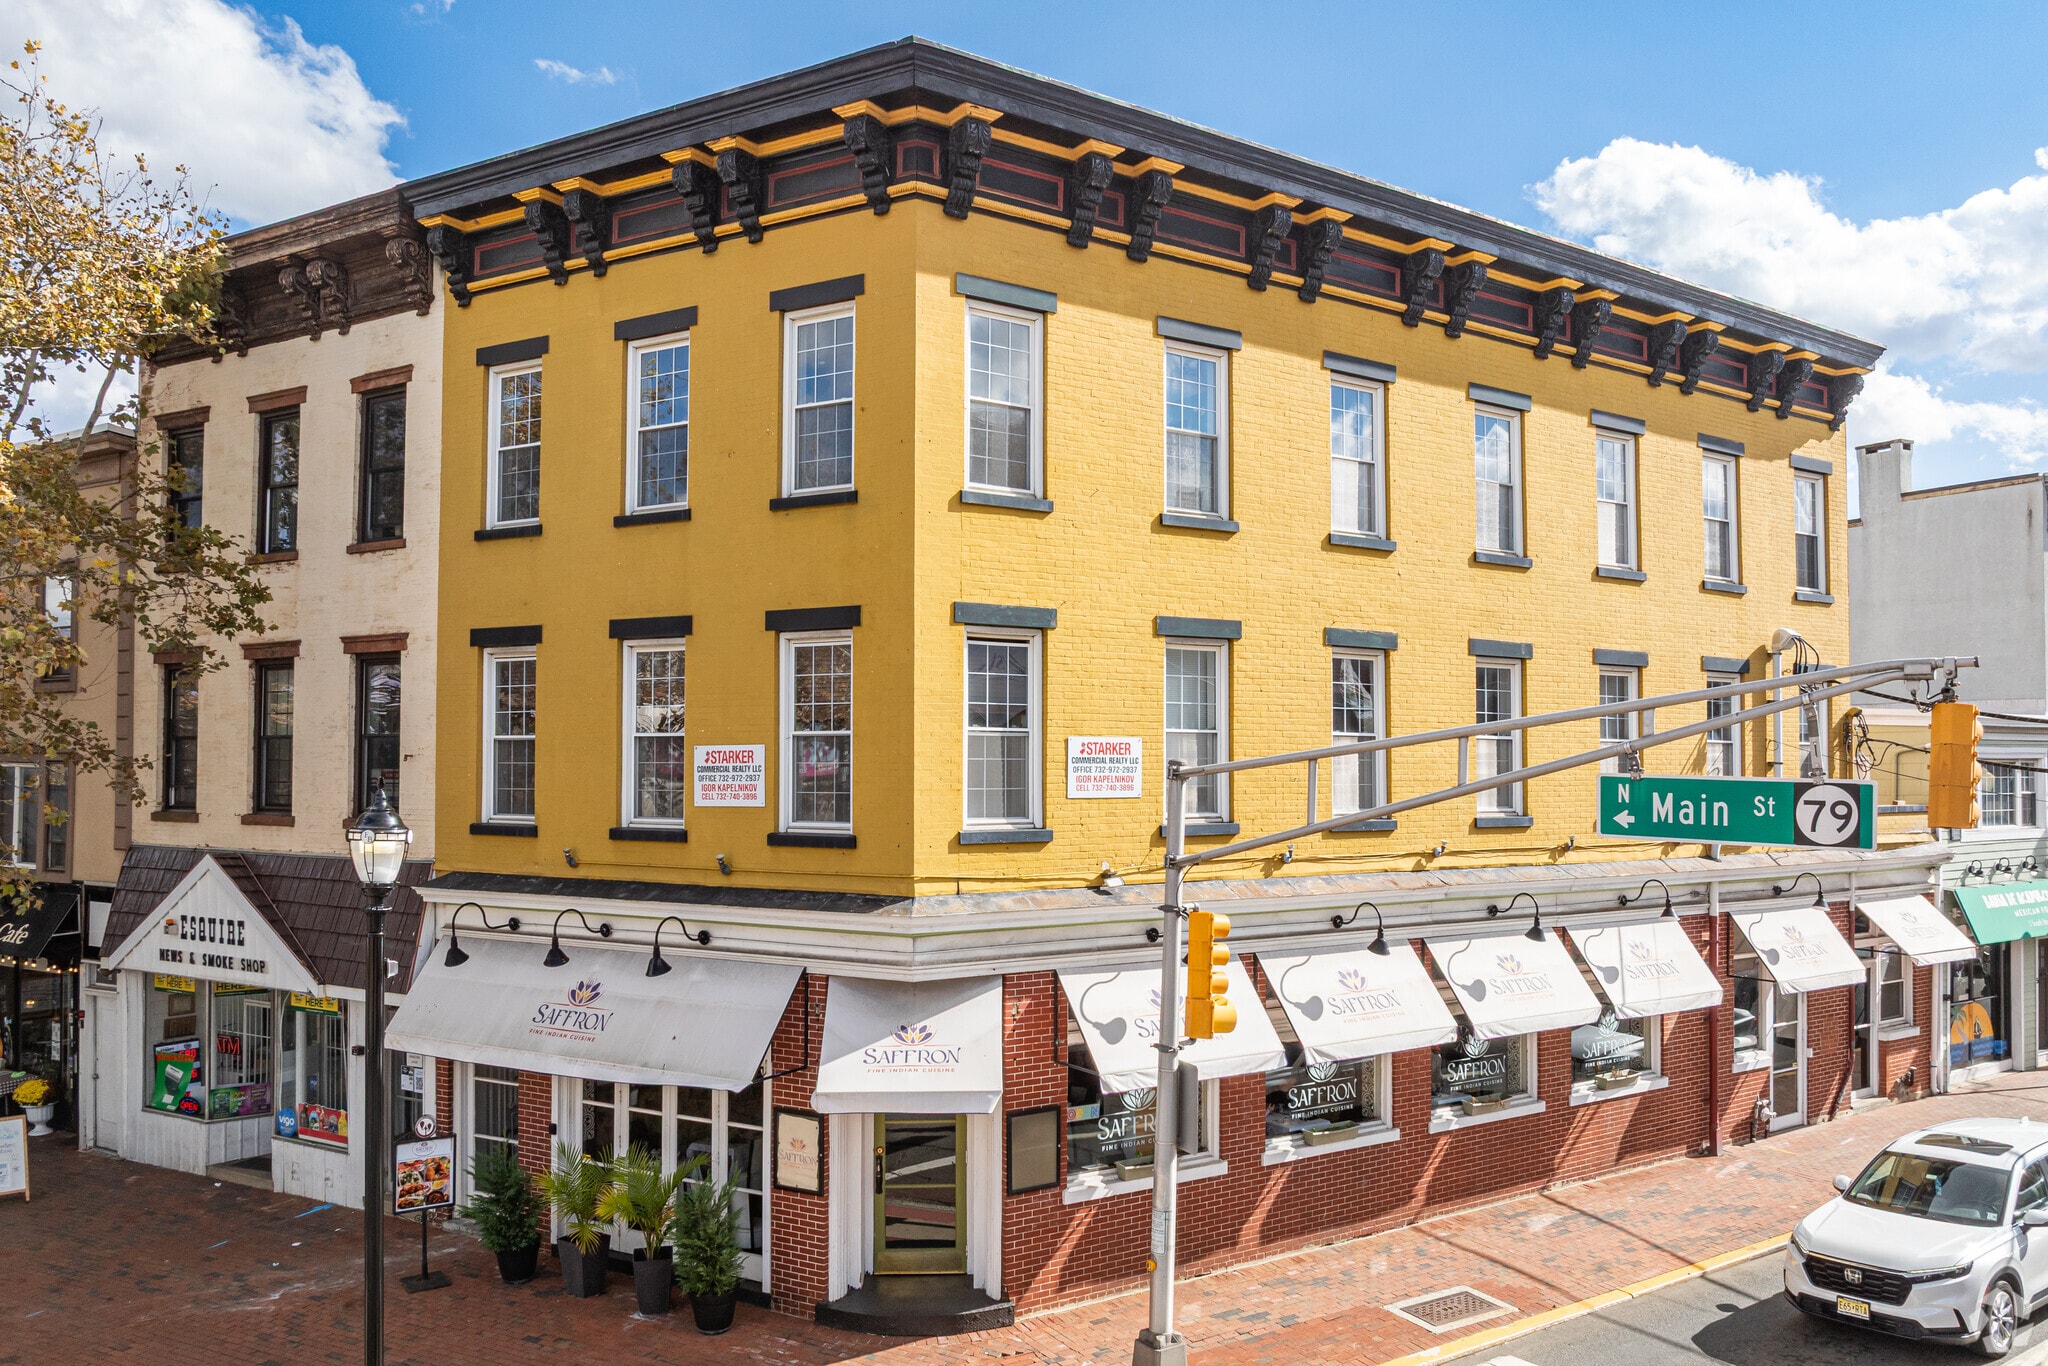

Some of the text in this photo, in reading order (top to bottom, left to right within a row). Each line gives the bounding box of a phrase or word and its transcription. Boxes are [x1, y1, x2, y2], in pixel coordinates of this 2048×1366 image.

[1086, 742, 1131, 755] STARKER
[711, 750, 754, 764] STARKER
[697, 765, 730, 773] COMMERCIAL
[1076, 775, 1135, 783] IGOR KAPELNIKOV
[701, 784, 758, 792] IGOR KAPELNIKOV
[1617, 783, 1776, 826] N Main St
[1803, 800, 1853, 834] 79
[0, 923, 30, 944] Cafe
[180, 914, 245, 947] ESQUIRE
[159, 948, 266, 973] NEWS & SMOKE SHOP
[1624, 959, 1680, 980] SAFFRON
[167, 980, 183, 989] HERE
[1489, 973, 1552, 995] SAFFRON
[305, 996, 323, 1008] HERE
[1327, 989, 1402, 1015] SAFFRON
[532, 1004, 614, 1031] SAFFRON
[569, 1034, 596, 1042] CUISINE
[863, 1047, 961, 1064] SAFFRON
[1583, 1038, 1631, 1058] SAFFRON
[1447, 1055, 1506, 1082] SAFFRON
[1288, 1078, 1357, 1108] SAFFRON
[180, 1101, 199, 1111] OPEN
[1068, 1105, 1098, 1120] OPEN
[1307, 1108, 1328, 1117] INDIAN
[1330, 1104, 1354, 1112] CUISINE
[279, 1115, 294, 1126] vigo
[1097, 1113, 1157, 1140] SAFFR
[1101, 1144, 1117, 1152] FINE
[1121, 1140, 1145, 1149] INDIAN
[779, 1150, 817, 1166] SAFFRON
